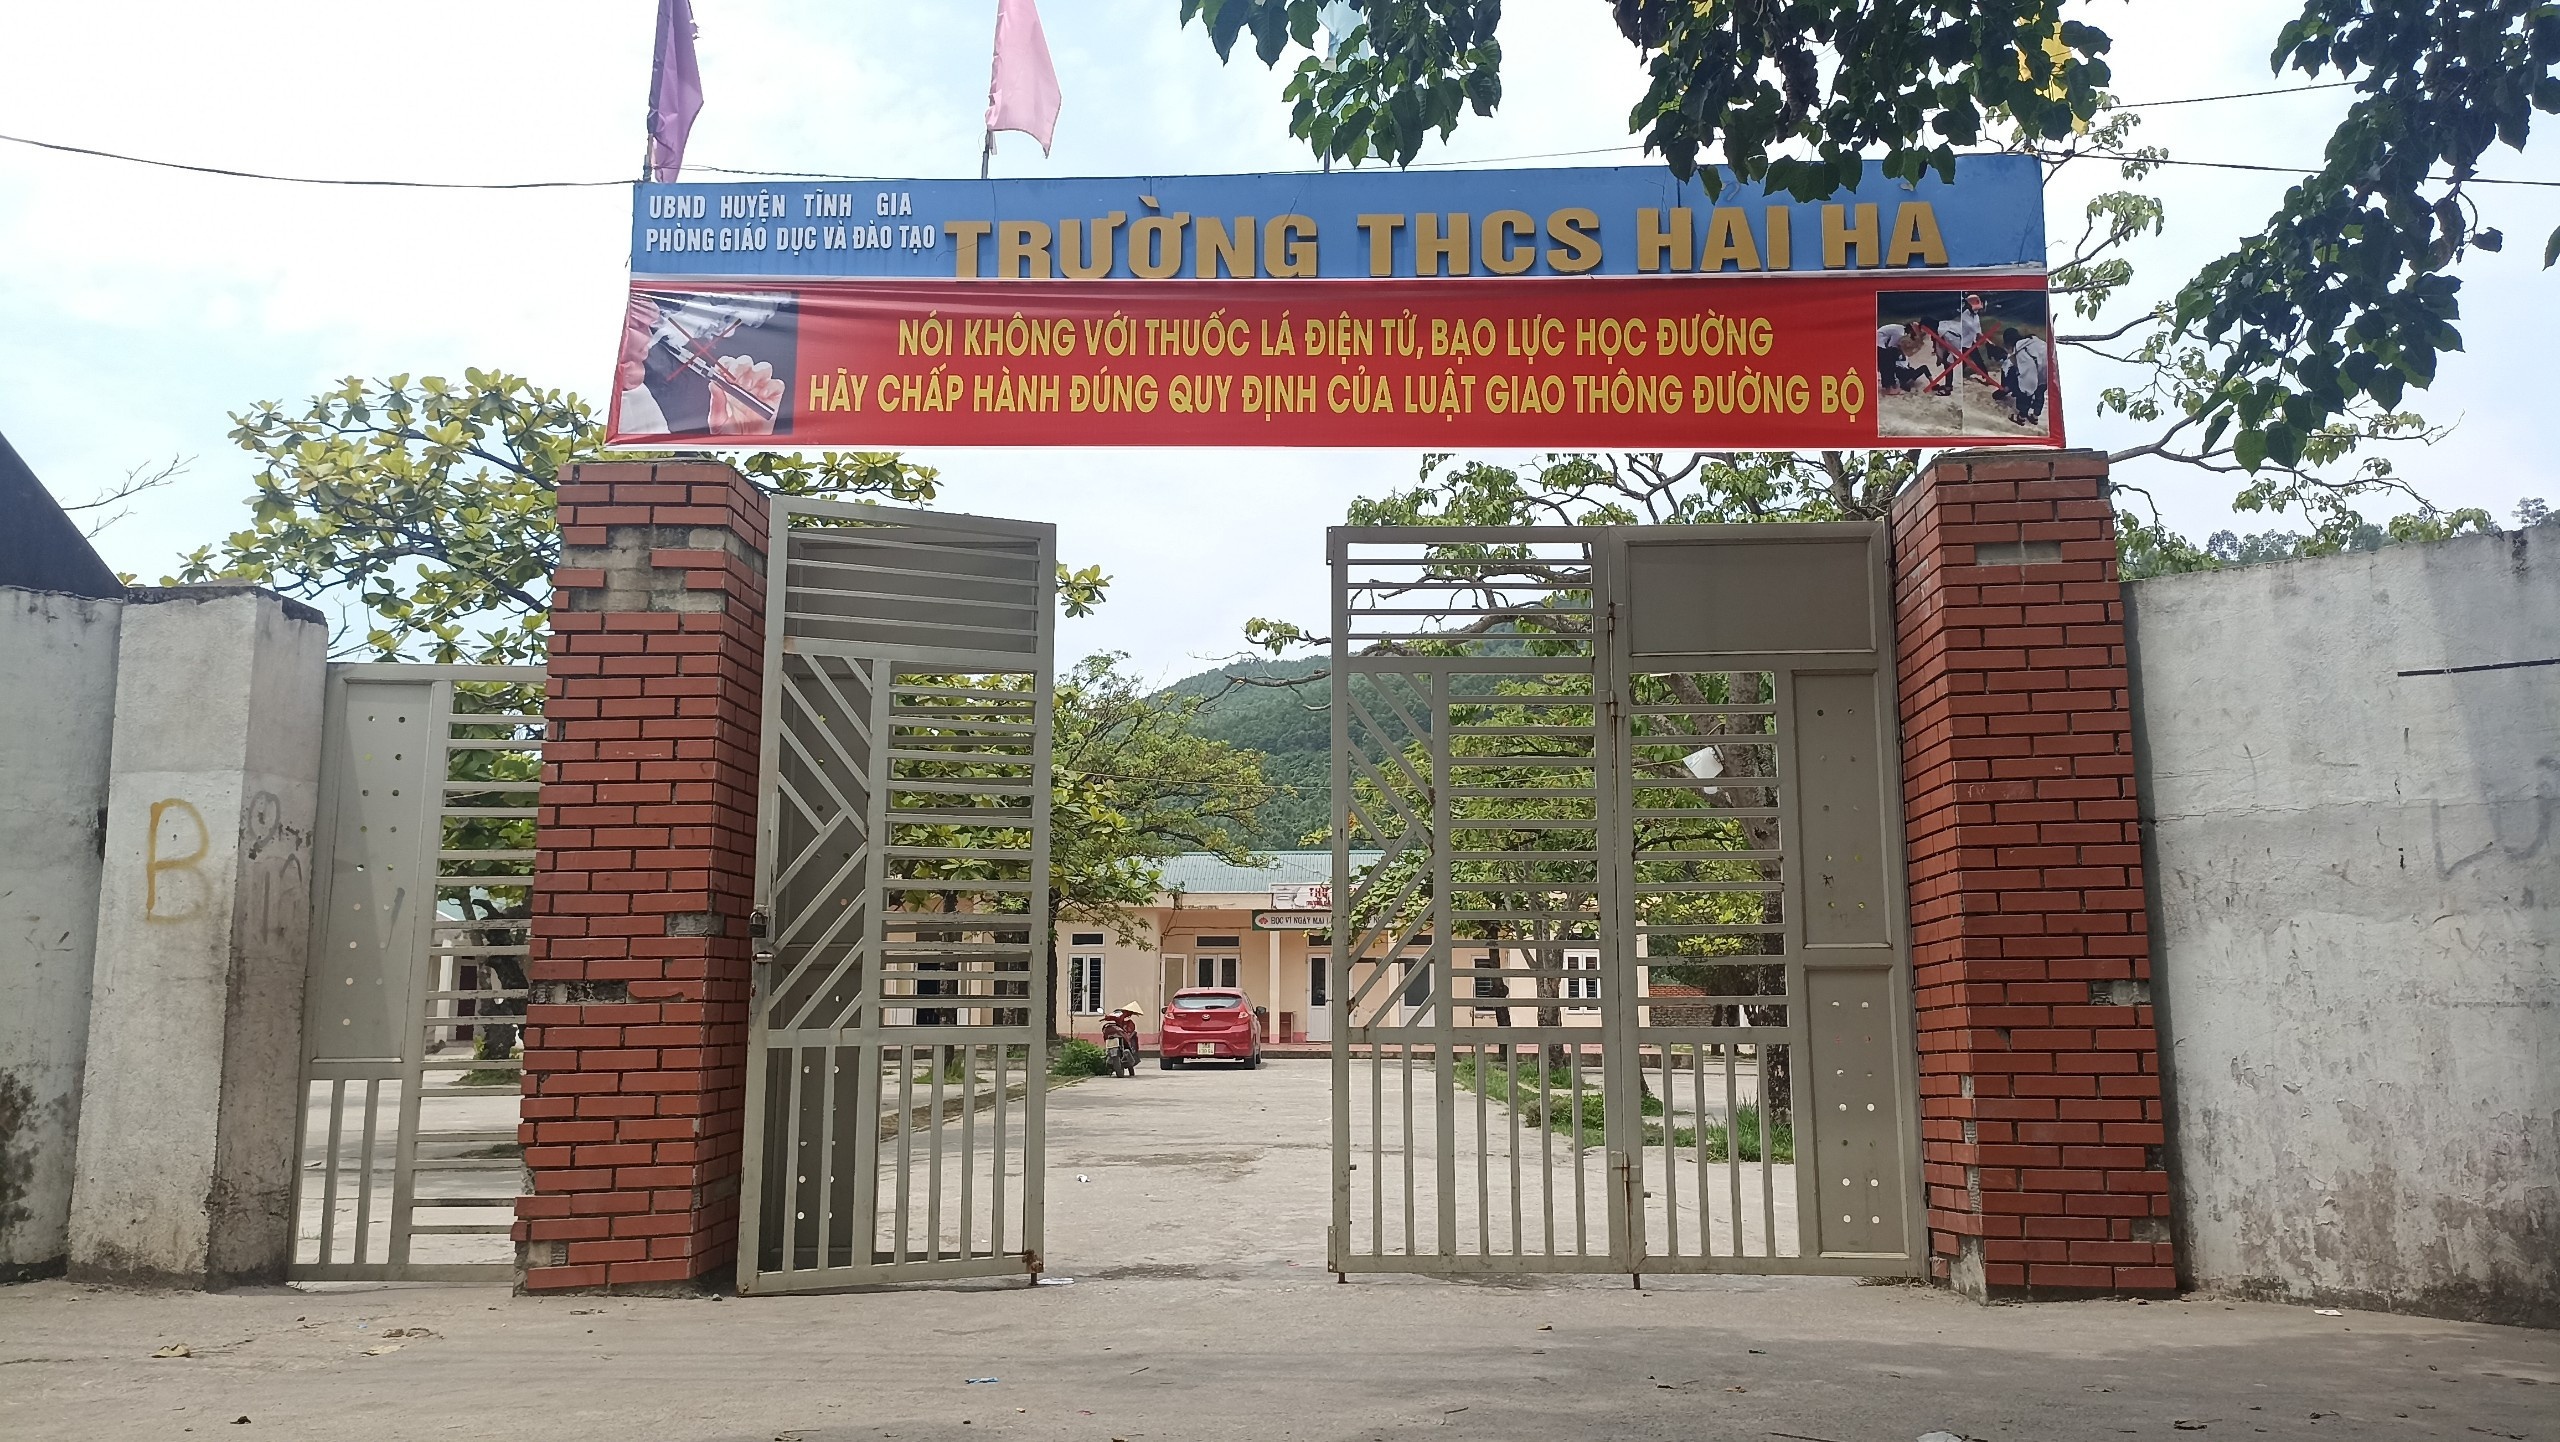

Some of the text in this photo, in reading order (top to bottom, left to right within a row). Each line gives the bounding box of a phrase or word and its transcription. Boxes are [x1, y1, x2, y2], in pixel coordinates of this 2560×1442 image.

[649, 189, 912, 222] UBND HUYỆN TĨNH GIA
[646, 219, 937, 256] PHÒNG GIÁO DỤC VÀ ĐÀO TẠO
[944, 194, 1319, 280] TRƯỜNG
[1356, 207, 1604, 277] THCS
[898, 307, 1775, 365] NÓI KHÔNG VỚI THUỐC LÁ ĐIỆN TỬ, BẠO LỰC HỌC ĐƯỜNG
[808, 362, 1866, 422] HÃY CHẤP HÀNH ĐÚNG QUY ĐỊNH CỦA LUẬT GIAO THÔNG ĐƯỜNG BỘ
[145, 797, 211, 924] B
